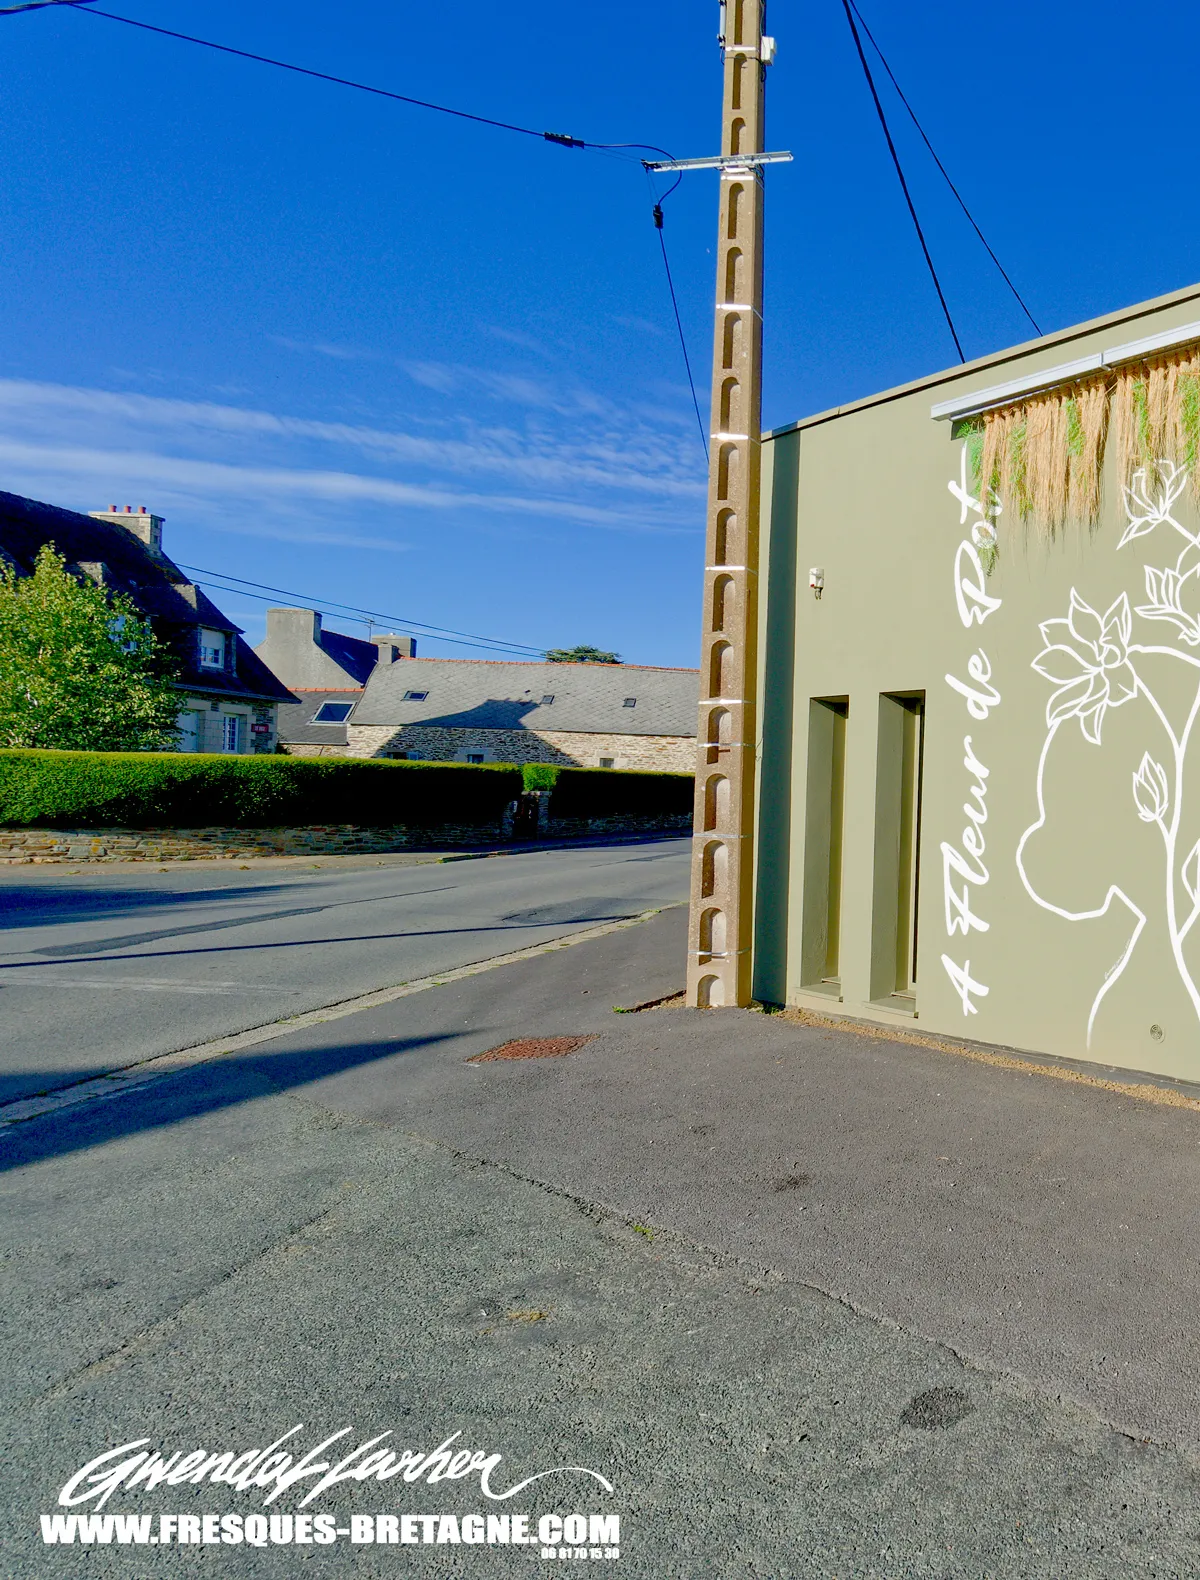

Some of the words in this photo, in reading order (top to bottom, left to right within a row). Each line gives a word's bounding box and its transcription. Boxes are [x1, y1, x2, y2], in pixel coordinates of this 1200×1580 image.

[948, 440, 1003, 628] Pot
[945, 647, 1001, 720] de
[940, 734, 990, 936] Fleur
[941, 953, 989, 1016] A
